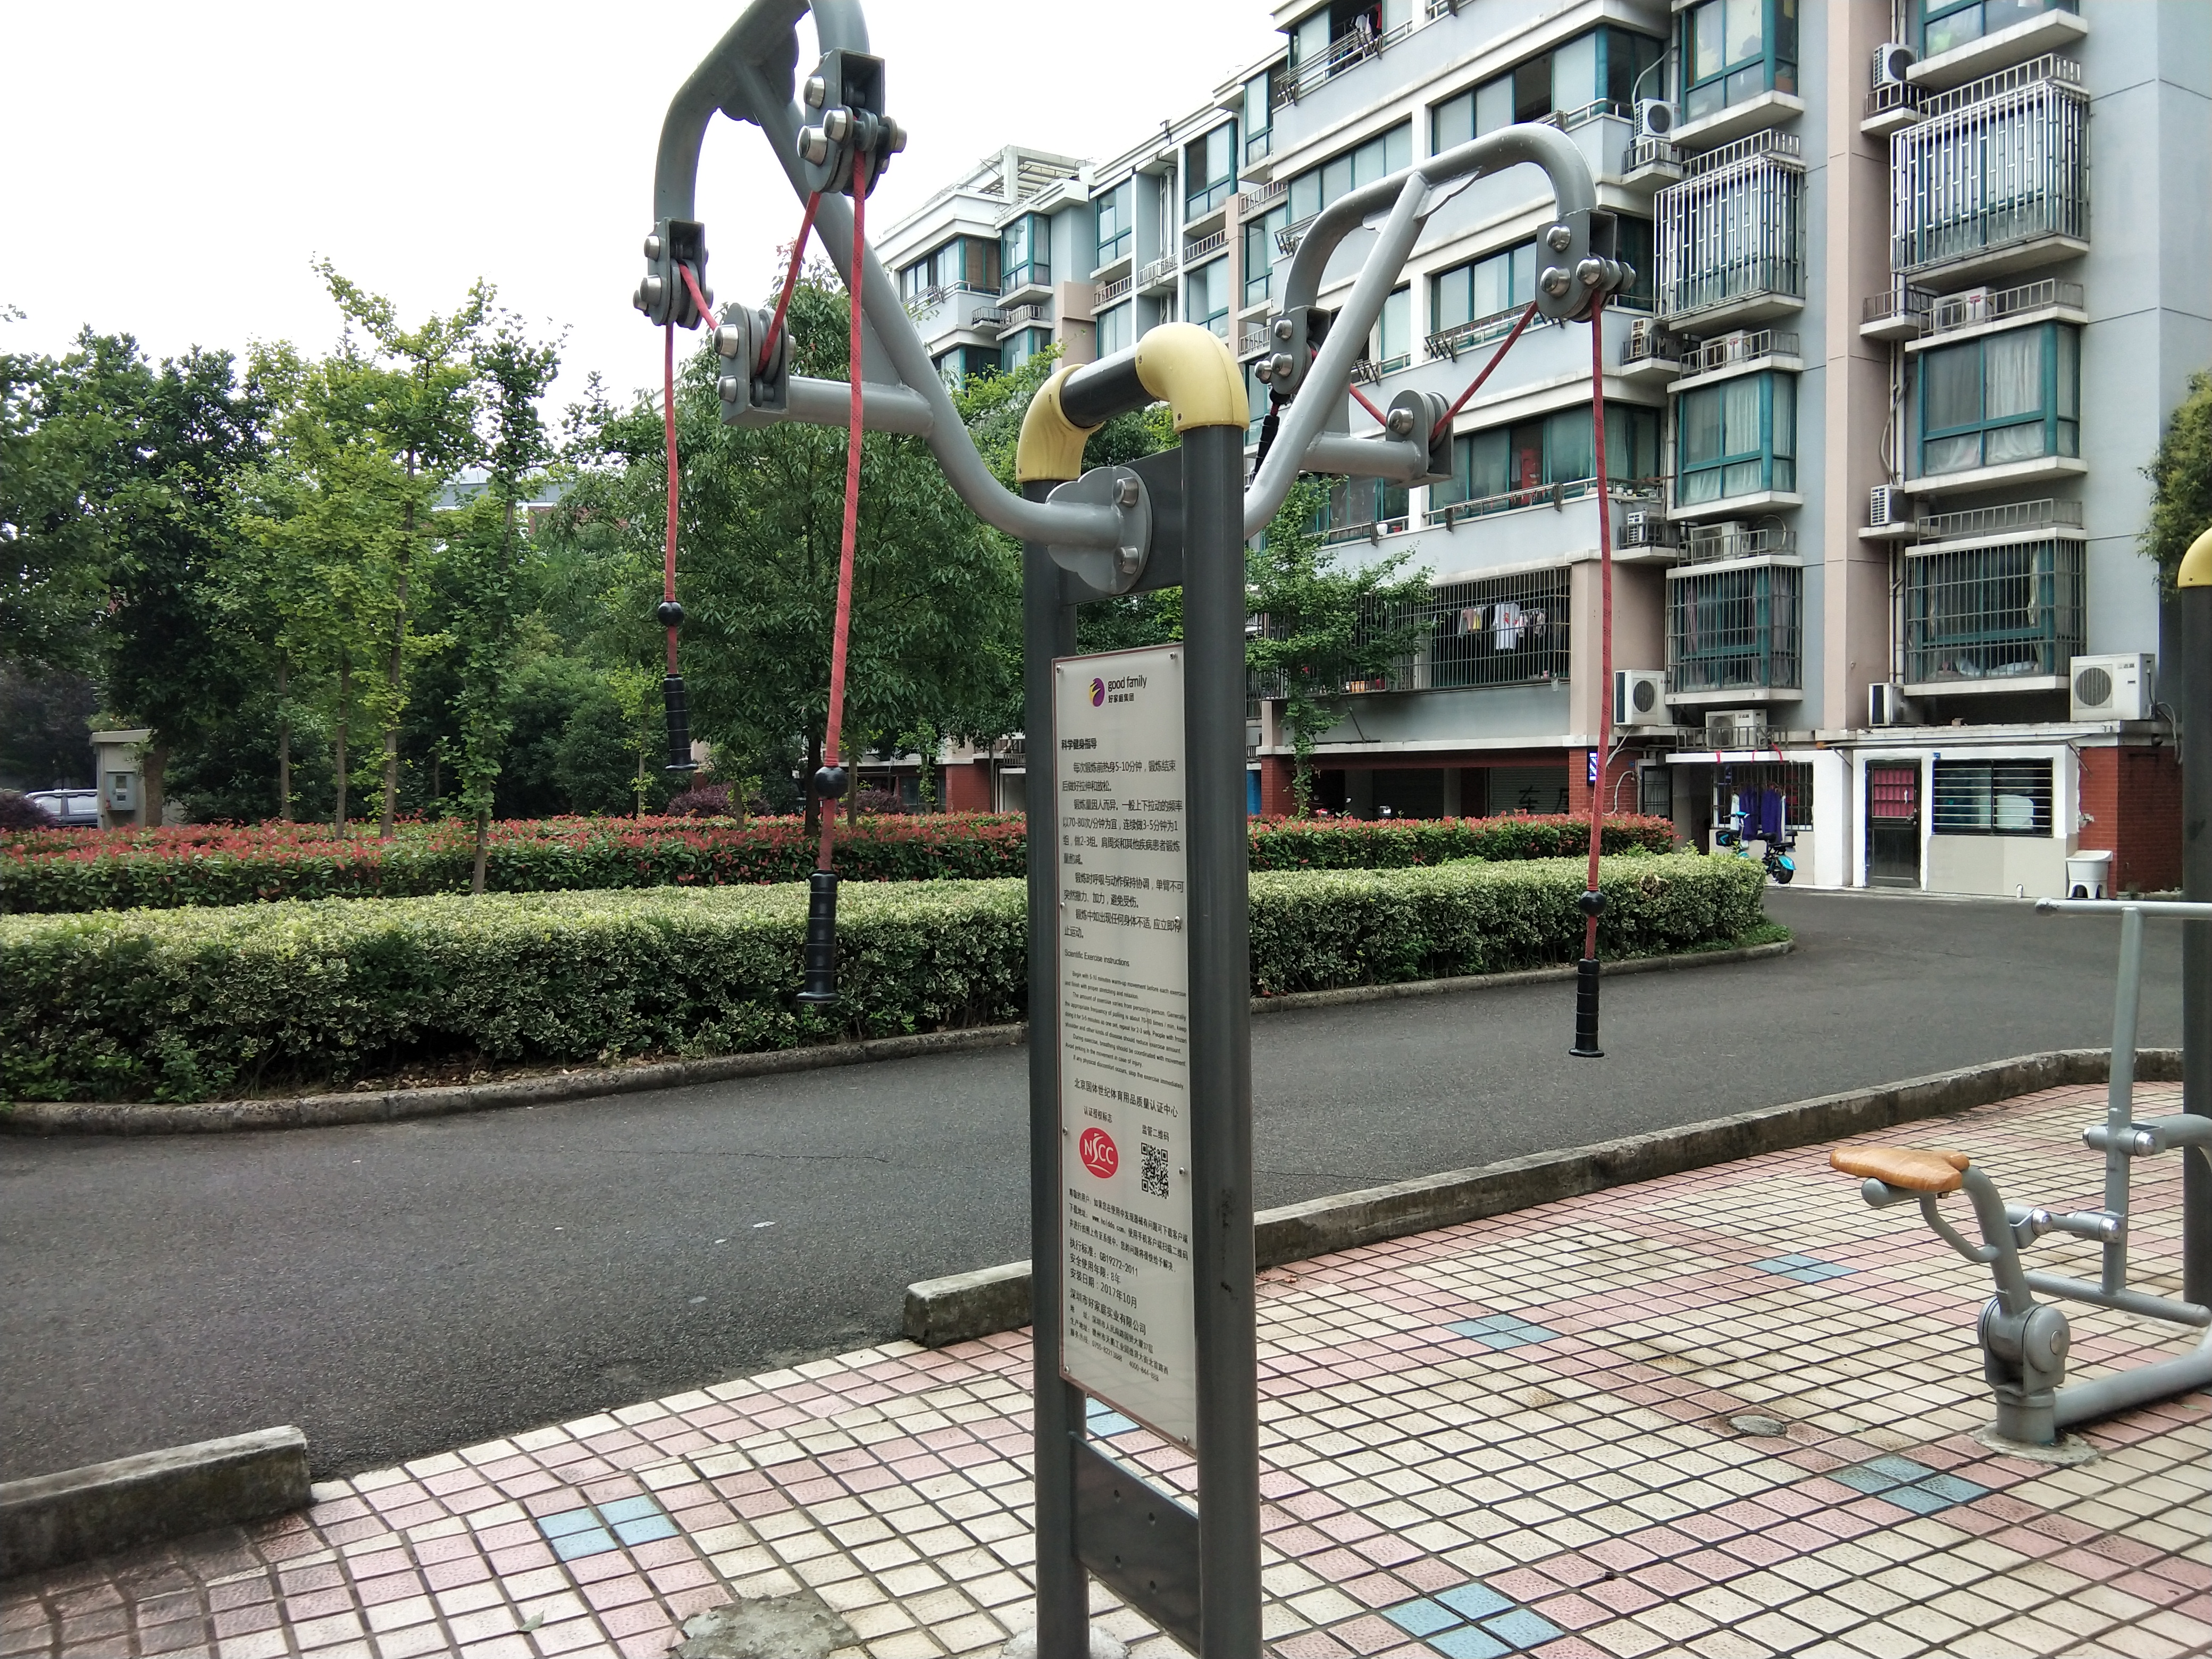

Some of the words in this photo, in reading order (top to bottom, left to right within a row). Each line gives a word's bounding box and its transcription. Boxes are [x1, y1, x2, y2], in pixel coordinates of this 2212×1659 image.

[1108, 677, 1125, 692] good
[1127, 675, 1147, 688] family
[1109, 693, 1134, 703] 好家庭集团
[1061, 738, 1096, 750] 科学健身指导
[1084, 952, 1103, 961] Exercise
[1075, 1079, 1177, 1117] 北京国体世纪体育用品质量认证中心
[1084, 1106, 1112, 1123] 认证授权标志
[1142, 1125, 1169, 1142] 监管二维码
[1084, 1133, 1114, 1164] NSCC
[1070, 1288, 1145, 1335] 深圳市好家庭实业有限公司
